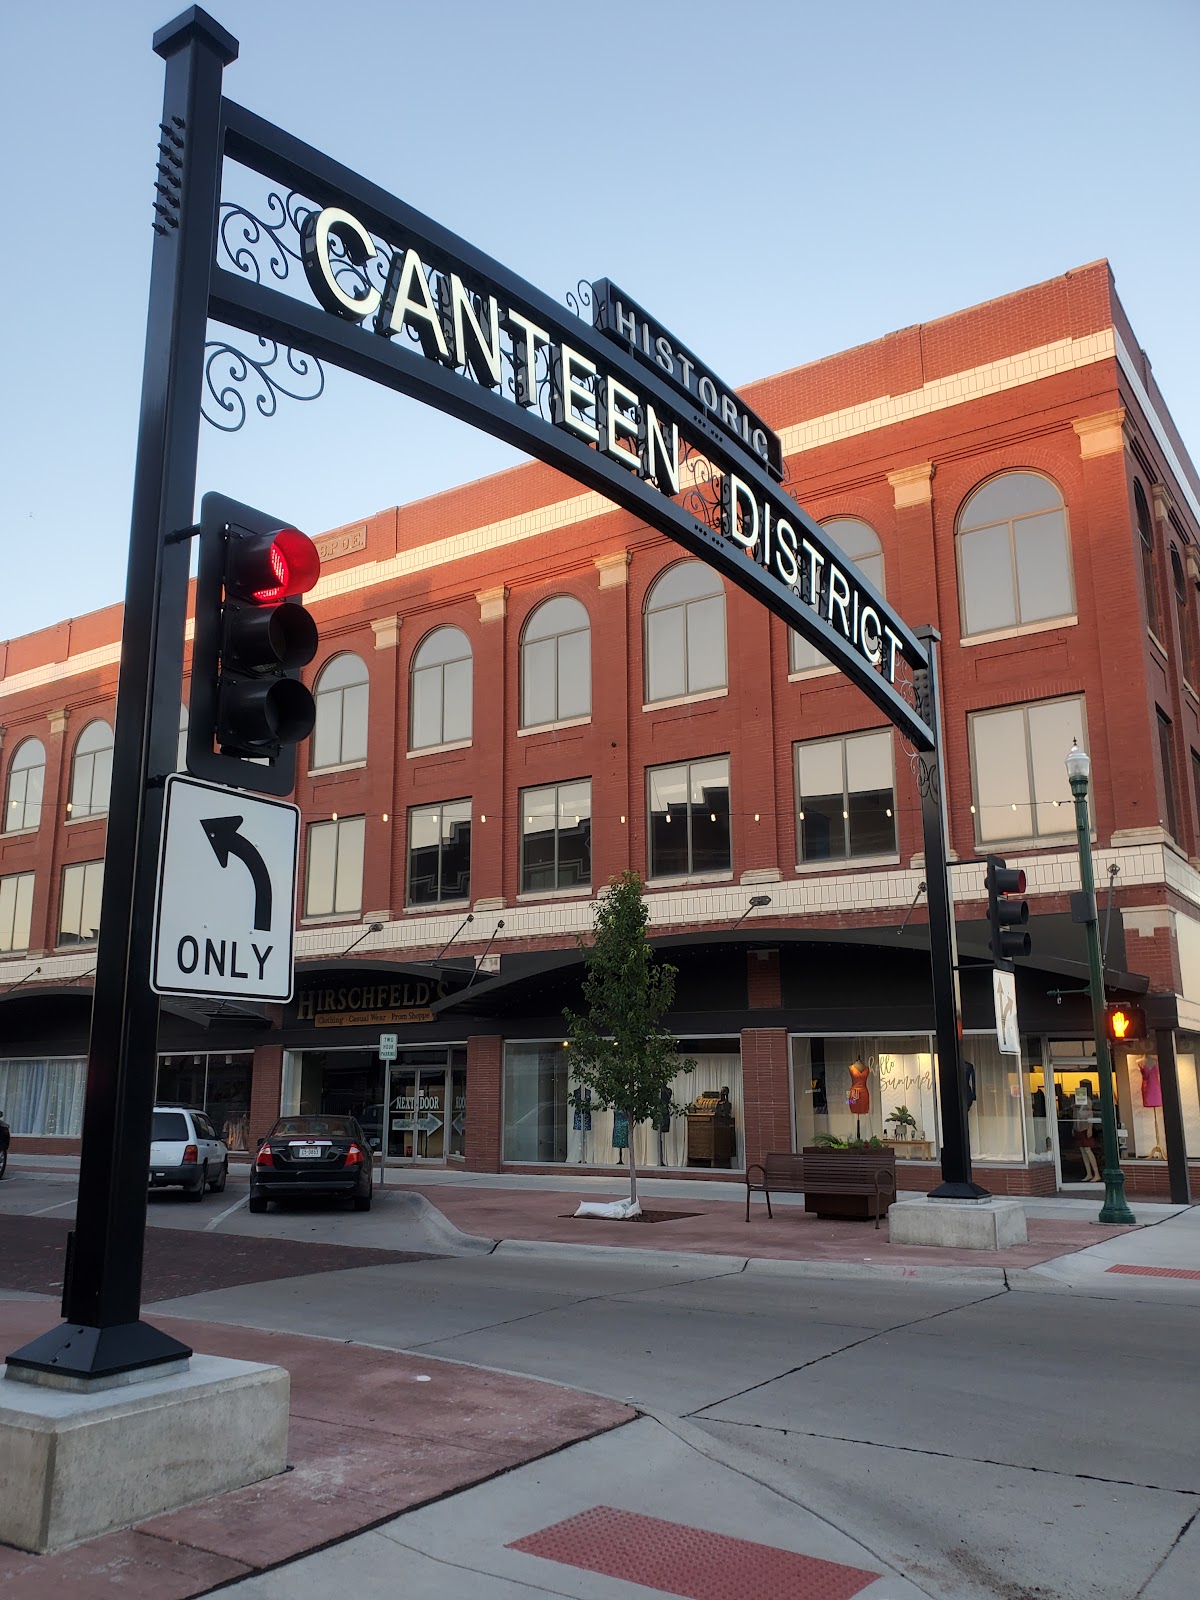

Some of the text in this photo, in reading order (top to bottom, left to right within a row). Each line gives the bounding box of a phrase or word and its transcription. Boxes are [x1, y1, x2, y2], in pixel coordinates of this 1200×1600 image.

[614, 300, 769, 462] HISTORIC
[304, 206, 904, 684] CANTEEN DISTRICT
[176, 934, 275, 981] ONLY
[296, 980, 449, 1020] HIRSCHFELD'S
[317, 1011, 431, 1025] Clothing Casual Wear Prom Shoppe
[395, 1095, 440, 1110] NEXT DOOR
